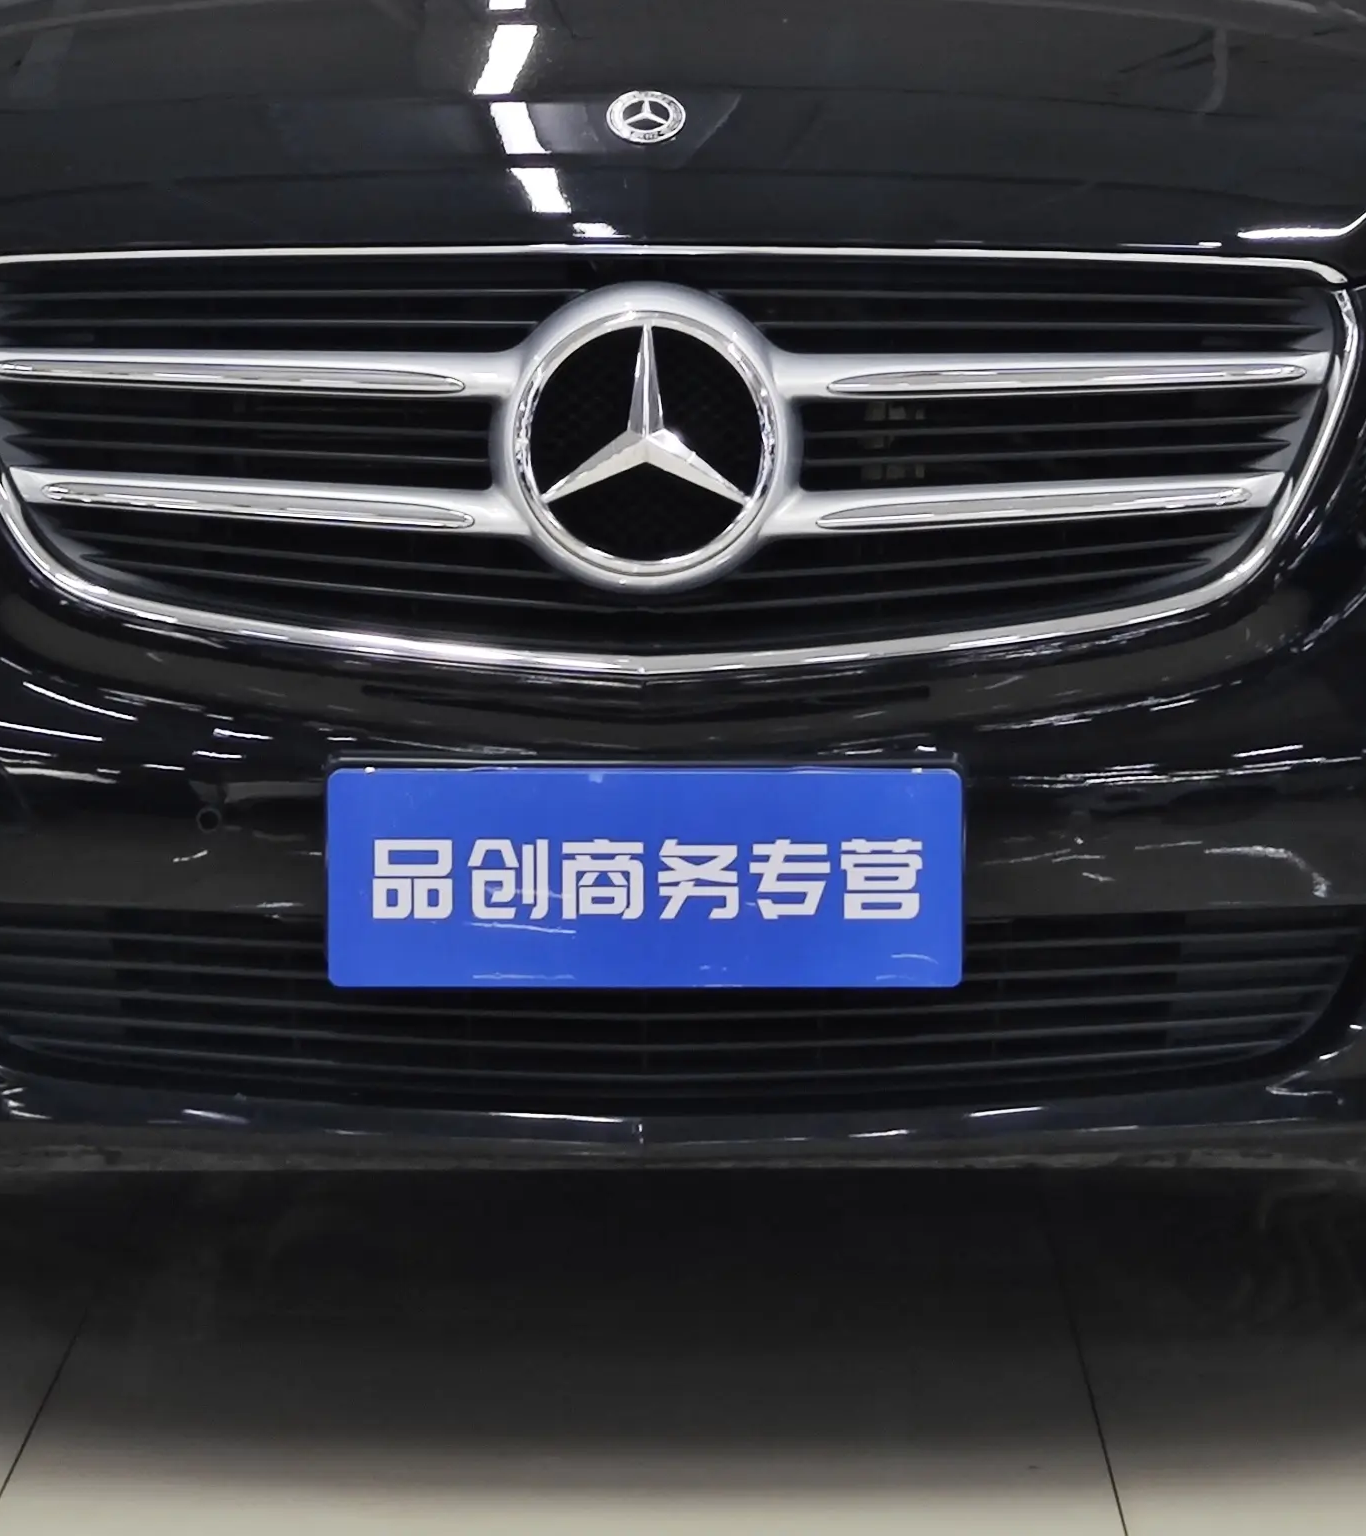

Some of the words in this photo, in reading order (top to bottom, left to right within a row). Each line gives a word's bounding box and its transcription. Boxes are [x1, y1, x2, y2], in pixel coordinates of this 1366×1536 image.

[372, 838, 923, 920] 品创商务专营
